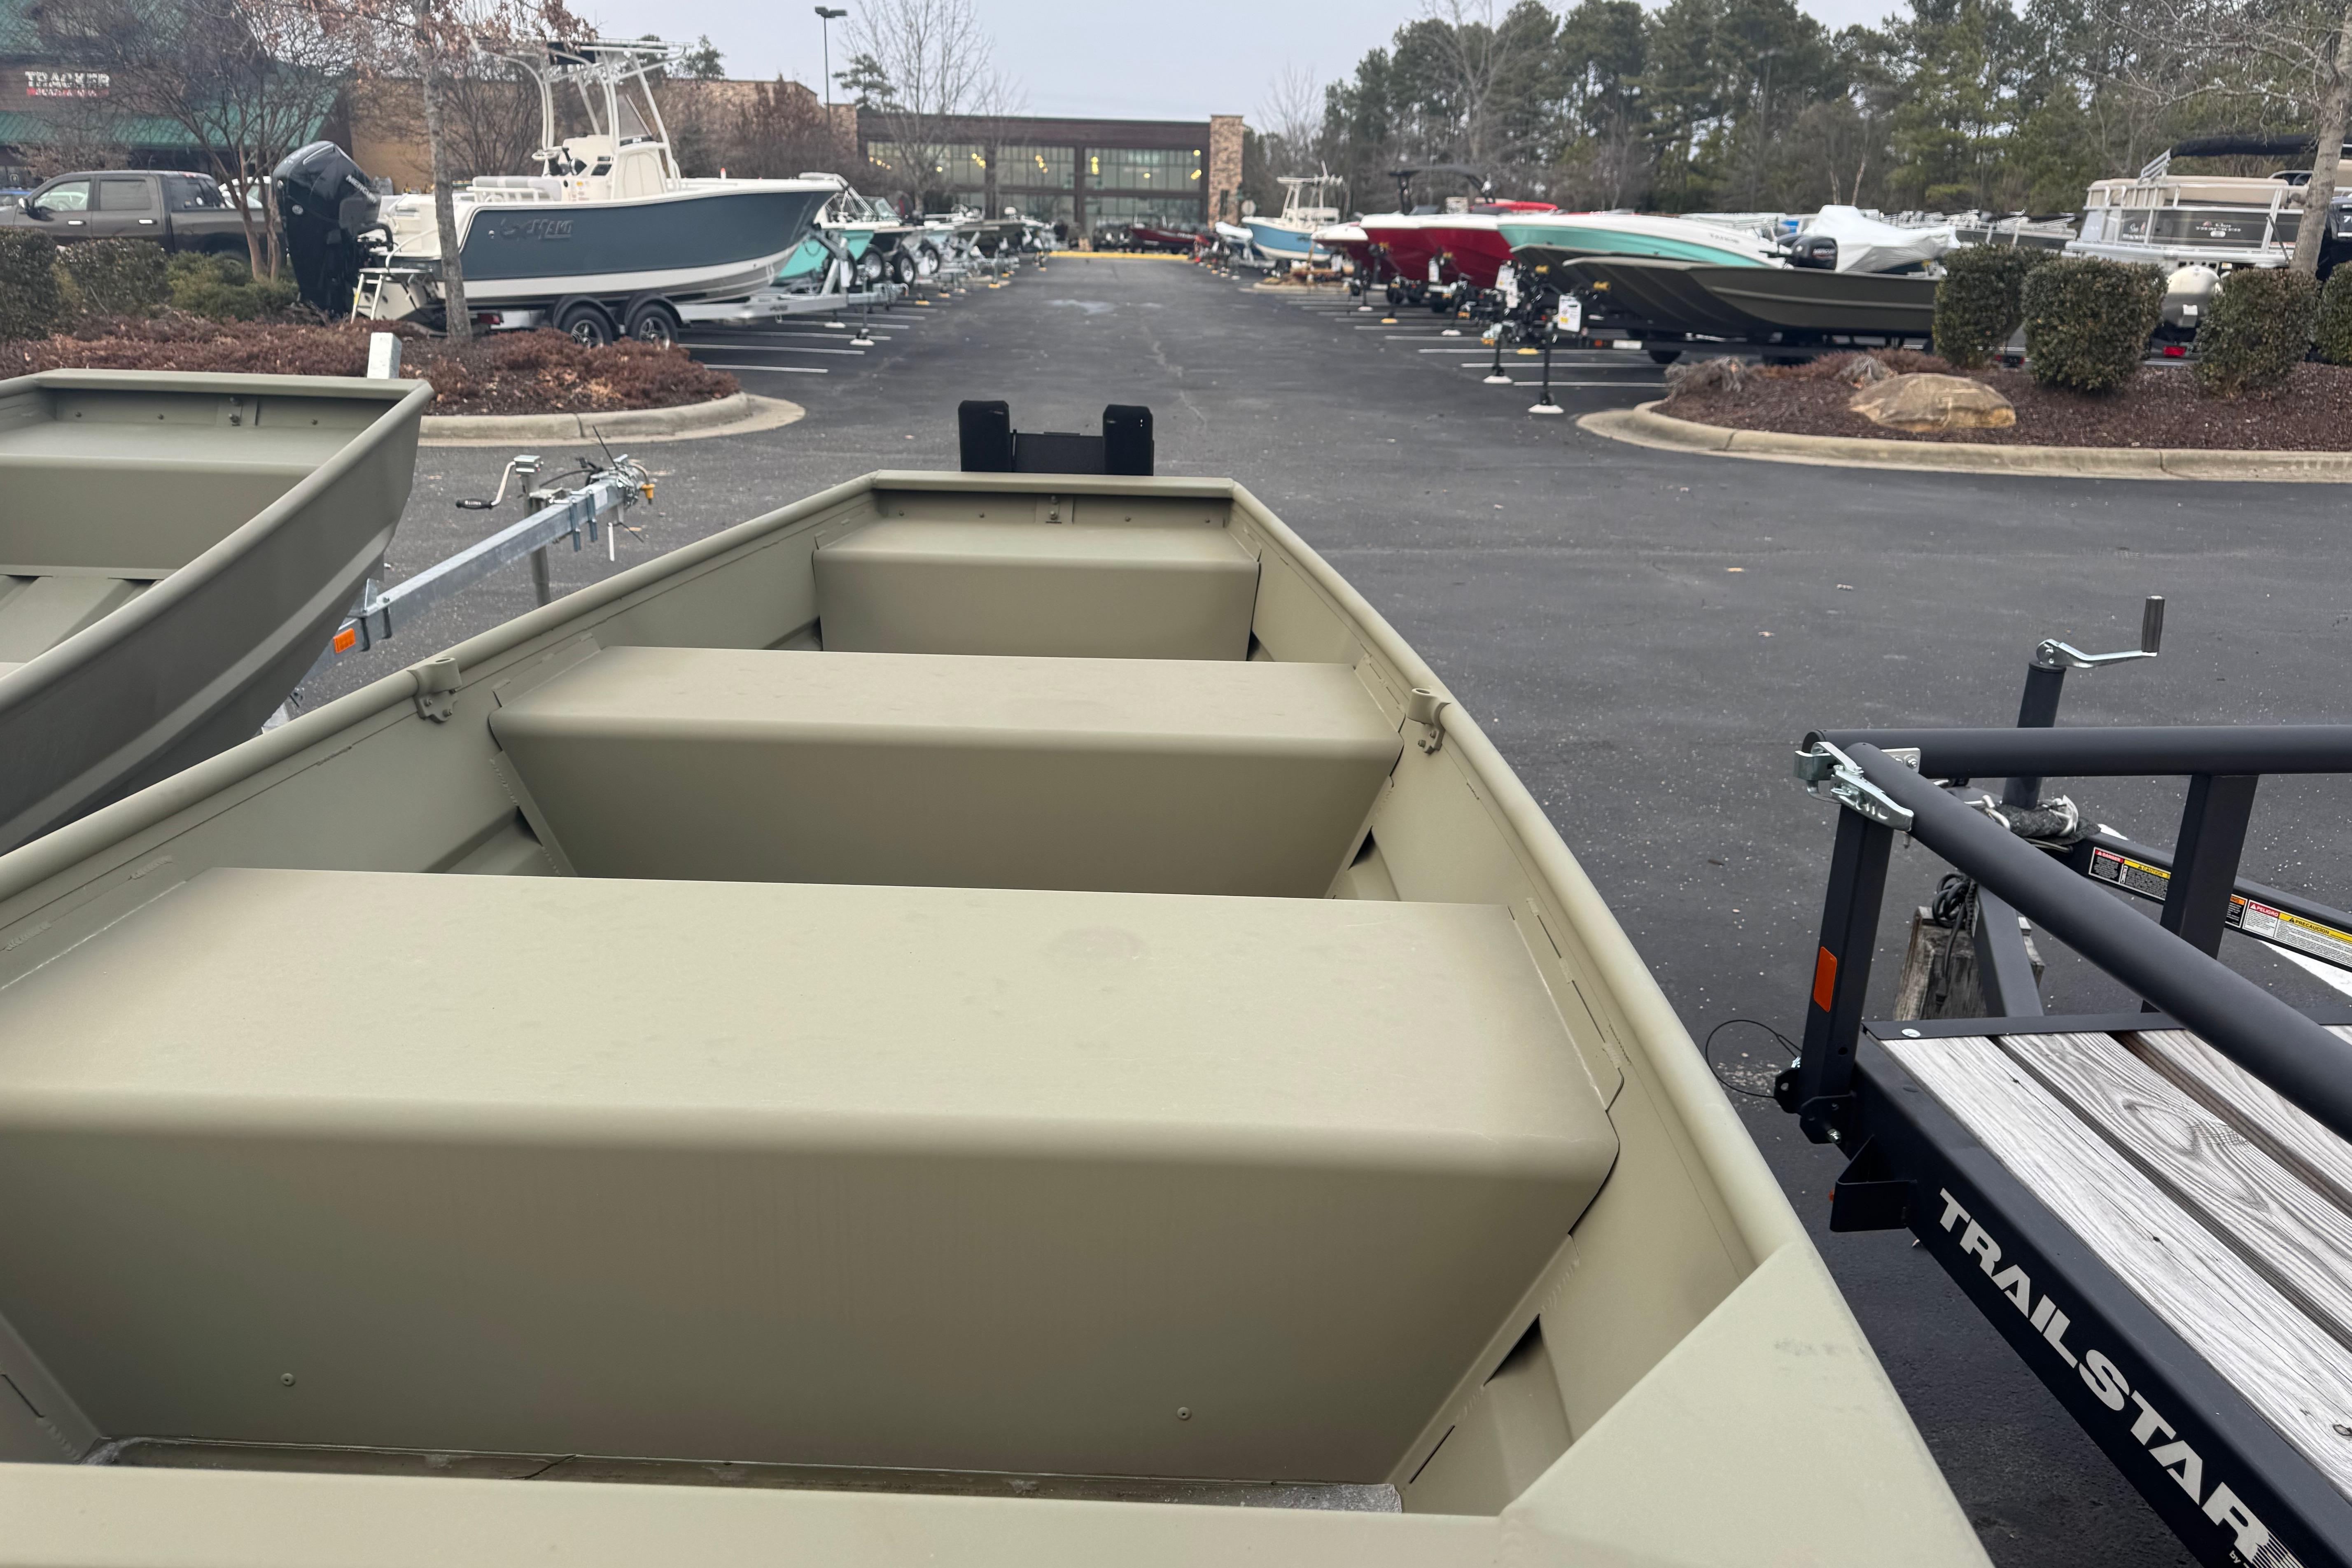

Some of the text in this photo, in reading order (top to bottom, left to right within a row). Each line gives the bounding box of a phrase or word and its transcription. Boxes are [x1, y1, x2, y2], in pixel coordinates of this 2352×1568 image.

[25, 71, 110, 88] TRACKER
[2256, 905, 2279, 917] PELIGRO
[1939, 1188, 2270, 1564] TRAILSTAR
[2229, 1550, 2241, 1563] by
